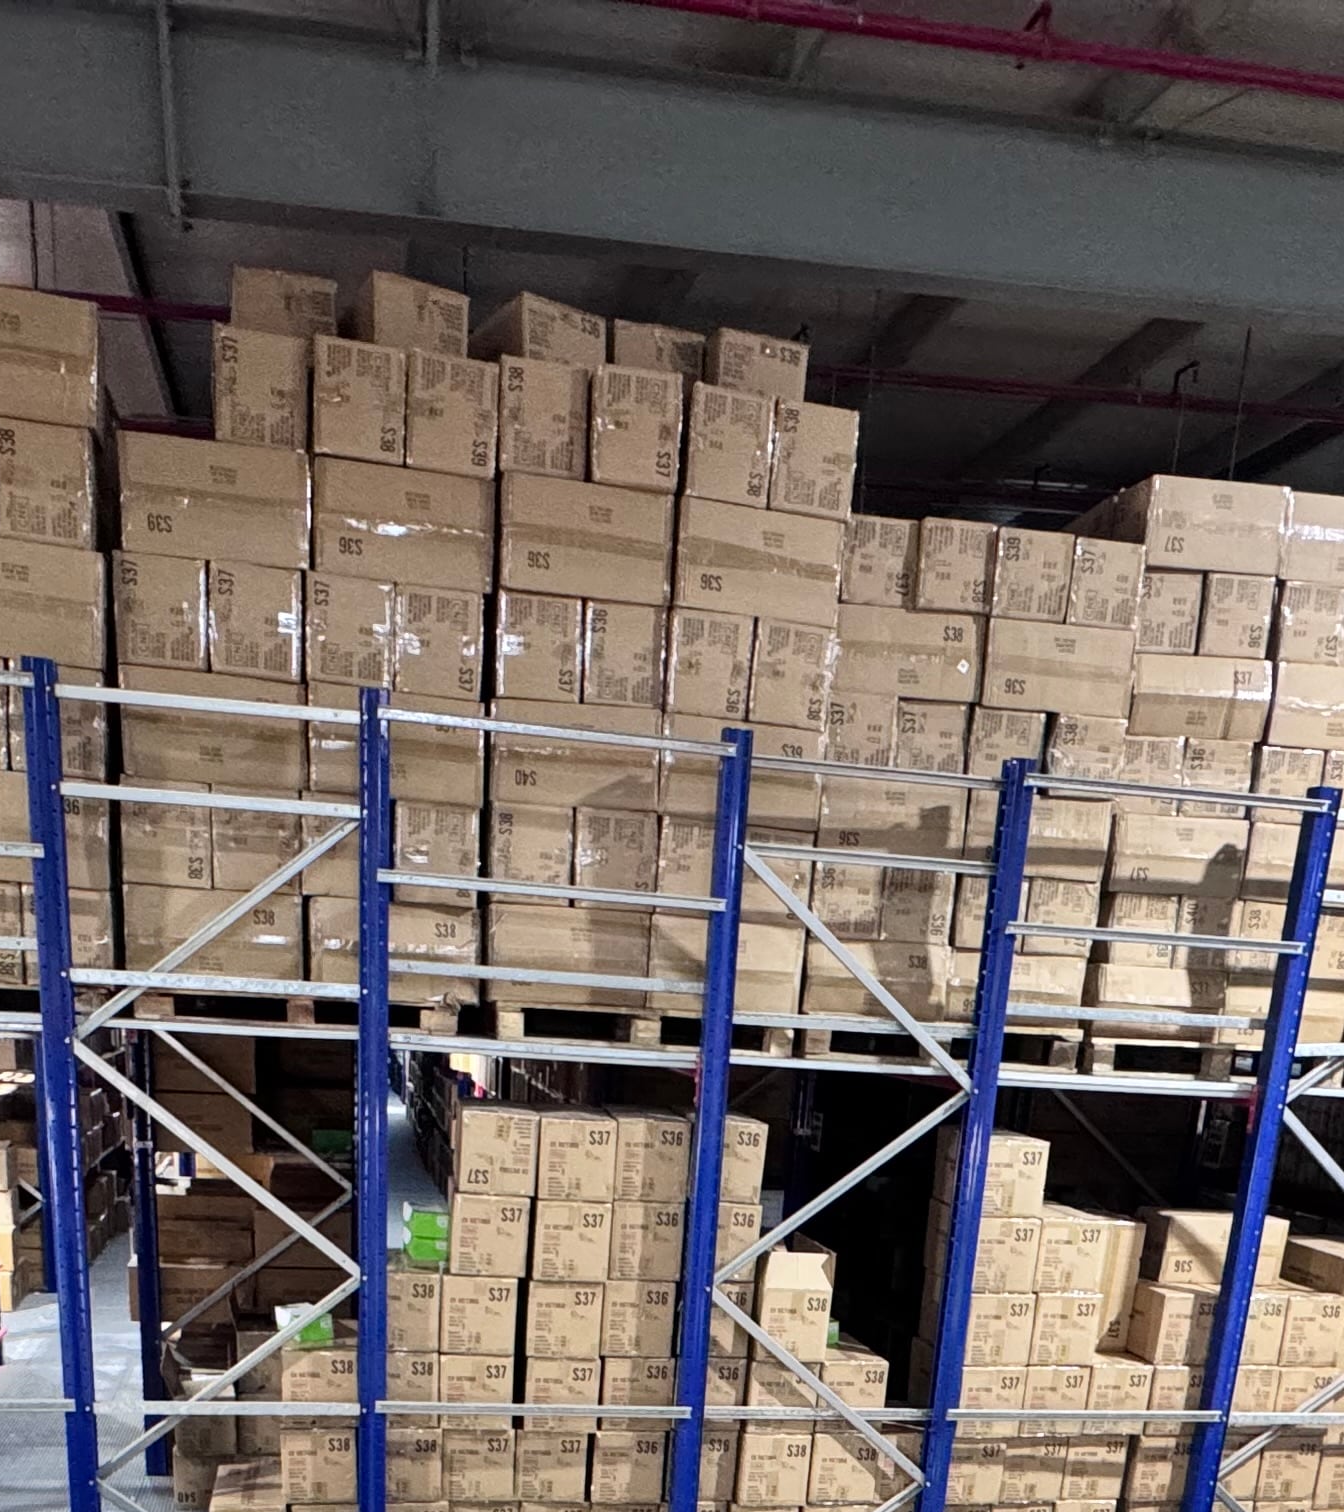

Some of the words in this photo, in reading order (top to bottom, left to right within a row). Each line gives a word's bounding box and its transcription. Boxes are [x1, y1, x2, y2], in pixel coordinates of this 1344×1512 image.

[221, 335, 238, 363] S37
[508, 366, 524, 392] S38
[784, 407, 800, 434] S38
[379, 426, 397, 453] S38
[471, 439, 488, 467] S39
[656, 451, 671, 478] S37
[747, 471, 762, 497] S38
[147, 513, 173, 533] S39
[338, 537, 363, 556] S36
[1004, 537, 1021, 562] S39
[1165, 536, 1185, 554] S37
[528, 551, 551, 570] S36
[1080, 549, 1096, 574] S37
[120, 560, 139, 586] S37
[218, 569, 234, 596] S37
[700, 573, 723, 592] S36
[313, 580, 330, 607] S37
[943, 626, 963, 643] S38
[1248, 624, 1263, 648] S36
[1324, 635, 1339, 658] S37
[458, 666, 474, 692] S37
[558, 669, 574, 693] S37
[1004, 678, 1026, 695] S36
[726, 688, 741, 713] S36
[807, 698, 823, 722] S38
[829, 702, 845, 725] S37
[515, 769, 537, 786] S40
[63, 800, 80, 815] 36
[839, 831, 860, 846] S36
[188, 856, 204, 880] S38
[1130, 867, 1150, 881] S37
[821, 866, 837, 890] S36
[252, 909, 275, 926] S38
[930, 913, 946, 936] S36
[434, 923, 457, 939] S38
[0, 952, 16, 976] S38
[589, 1130, 610, 1146] S37
[661, 1129, 684, 1146] S36
[736, 1131, 761, 1148] S36
[1022, 1151, 1042, 1166] S37
[466, 1168, 489, 1185] S37
[500, 1207, 523, 1223] S37
[582, 1213, 605, 1229] S37
[655, 1211, 679, 1227] S36
[732, 1211, 755, 1228] S36
[1014, 1228, 1034, 1242] S37
[1081, 1229, 1100, 1243] S37
[1174, 1260, 1192, 1272] S36
[411, 1283, 435, 1299] S38
[488, 1287, 511, 1302] S37
[574, 1291, 597, 1306] S37
[645, 1289, 669, 1306] S36
[1009, 1303, 1030, 1317] S37
[1077, 1304, 1096, 1316] S37
[1321, 1305, 1341, 1319] S36
[331, 1359, 354, 1375] S38
[411, 1361, 434, 1376] S38
[486, 1364, 507, 1379] S37
[571, 1367, 593, 1382] S37
[646, 1365, 668, 1380] S36
[864, 1369, 885, 1384] S38
[1000, 1377, 1020, 1390] S37
[1065, 1375, 1084, 1389] S37
[1129, 1375, 1147, 1388] S37
[415, 1439, 437, 1453] S38
[487, 1438, 509, 1452] S37
[560, 1439, 581, 1454] S37
[636, 1439, 658, 1455] S36
[786, 1444, 807, 1457] S38
[1043, 1444, 1062, 1456] S37
